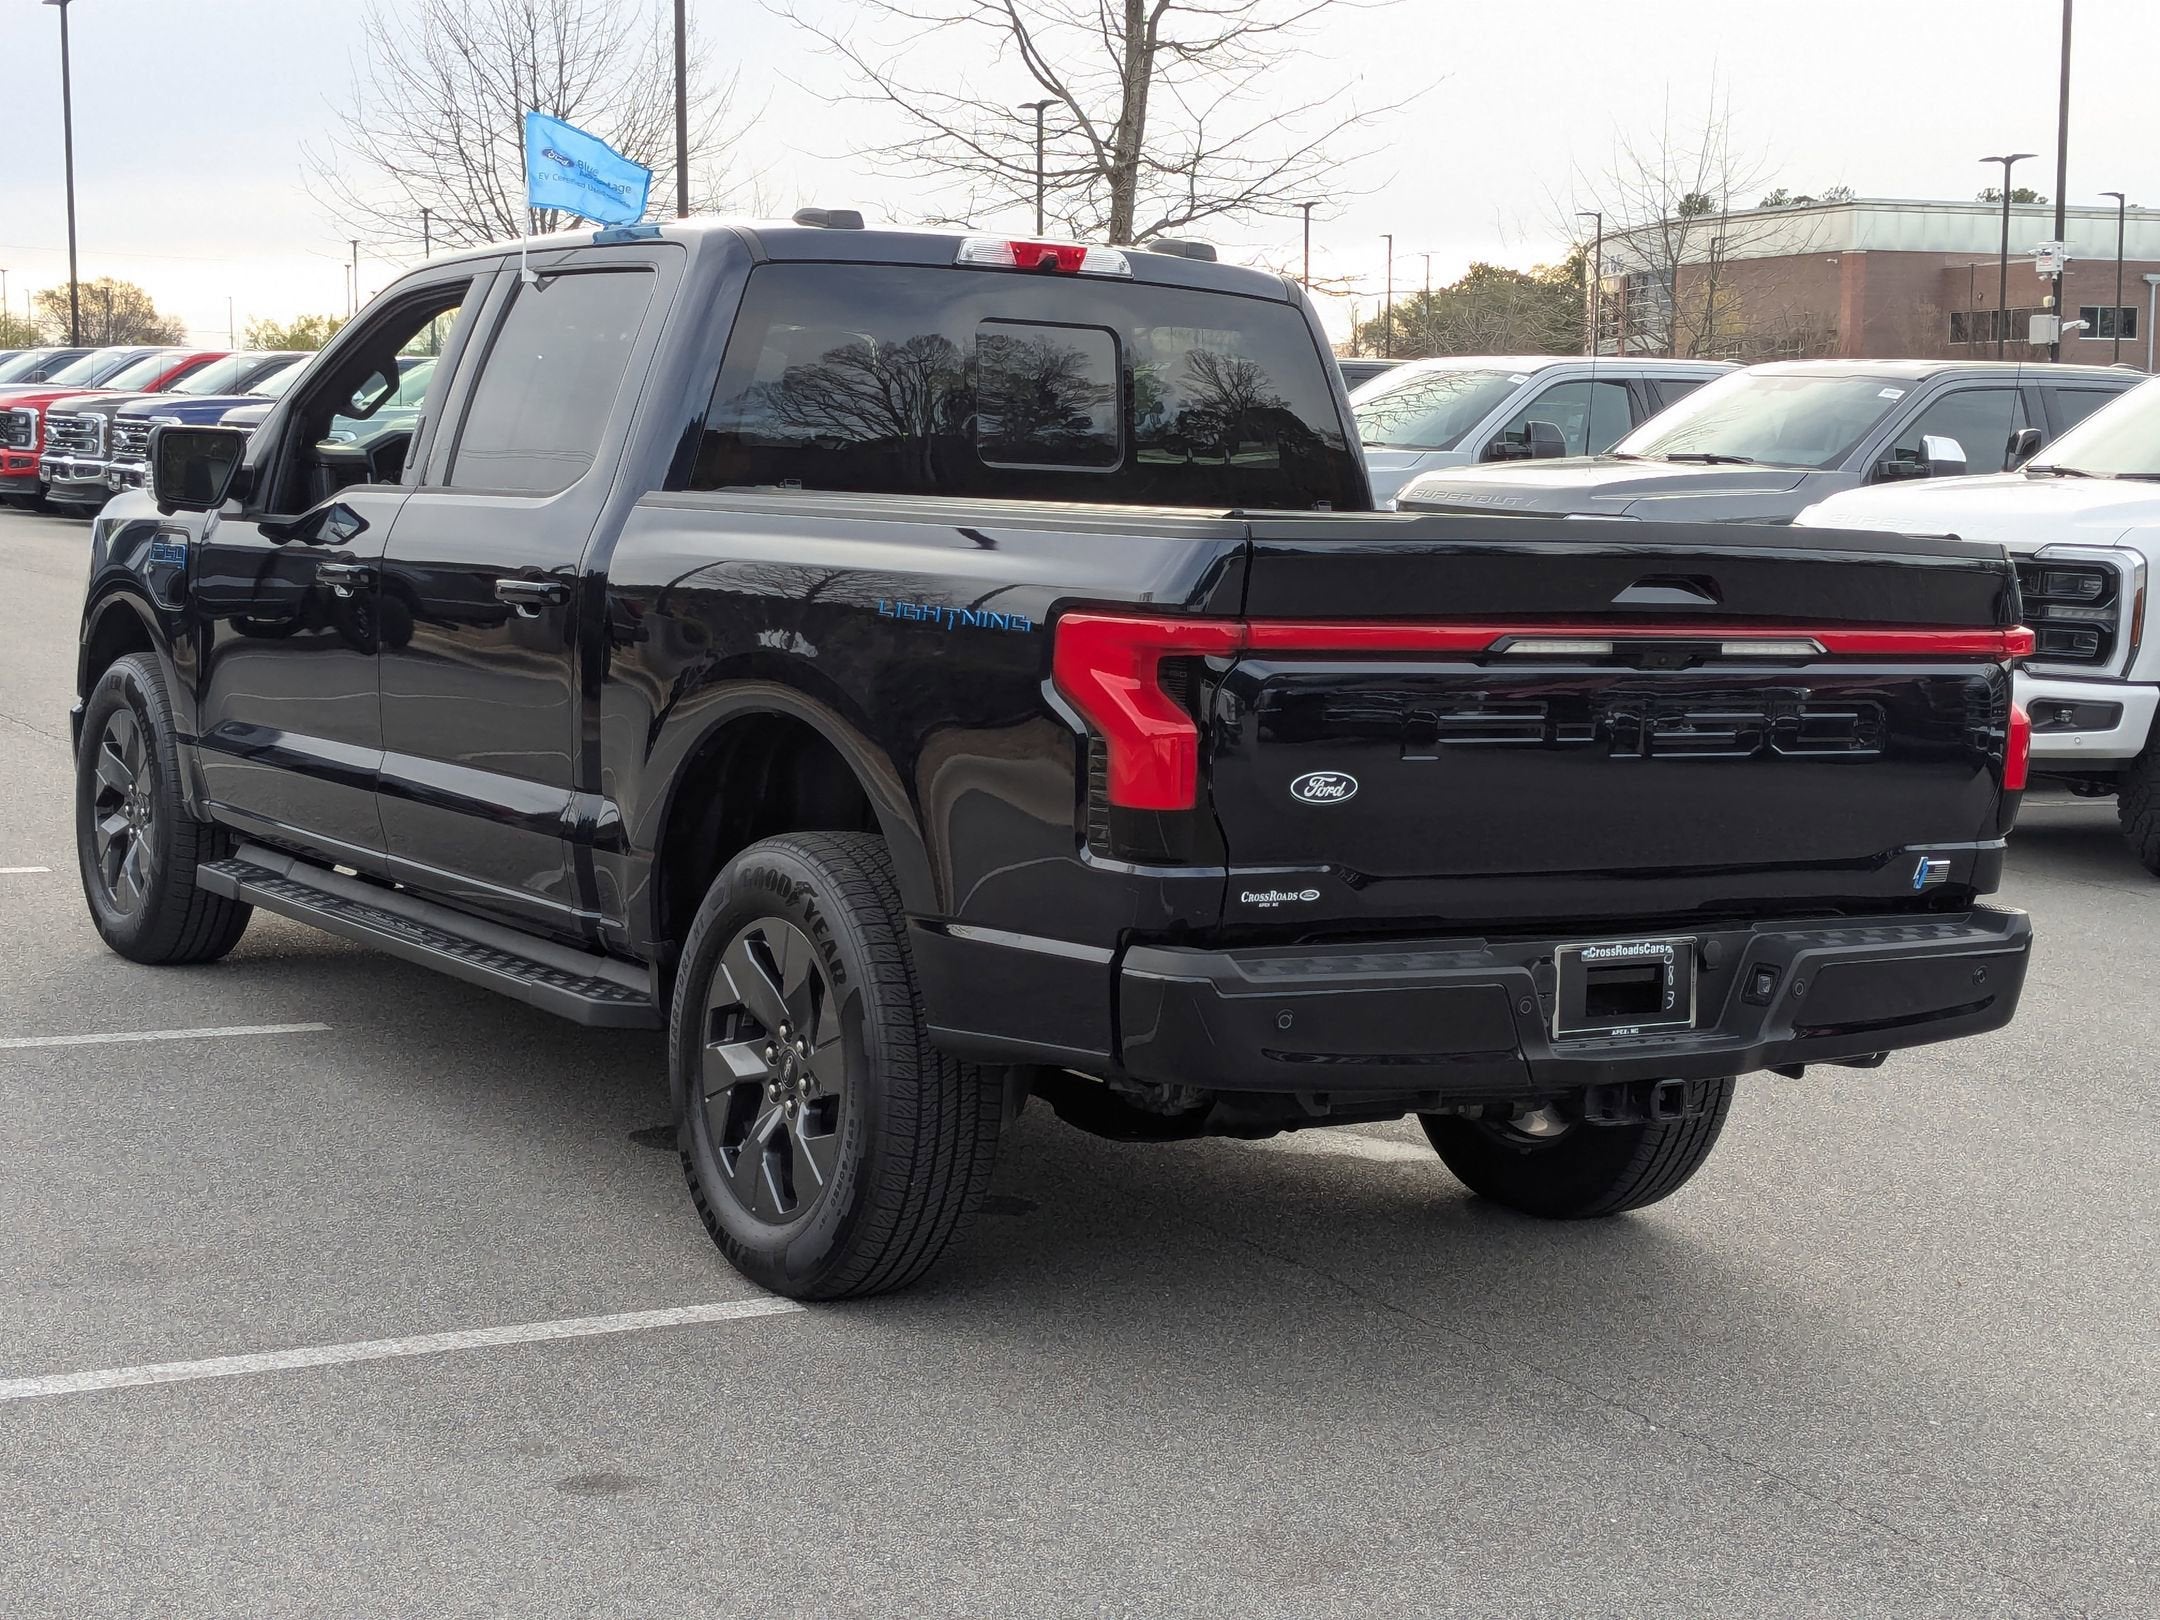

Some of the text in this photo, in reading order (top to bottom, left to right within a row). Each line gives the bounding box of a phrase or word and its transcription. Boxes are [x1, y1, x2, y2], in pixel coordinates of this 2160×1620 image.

[538, 172, 549, 181] EV
[577, 159, 600, 176] Blue
[878, 598, 1033, 633] LIGHTNING
[1303, 776, 1347, 797] Ford
